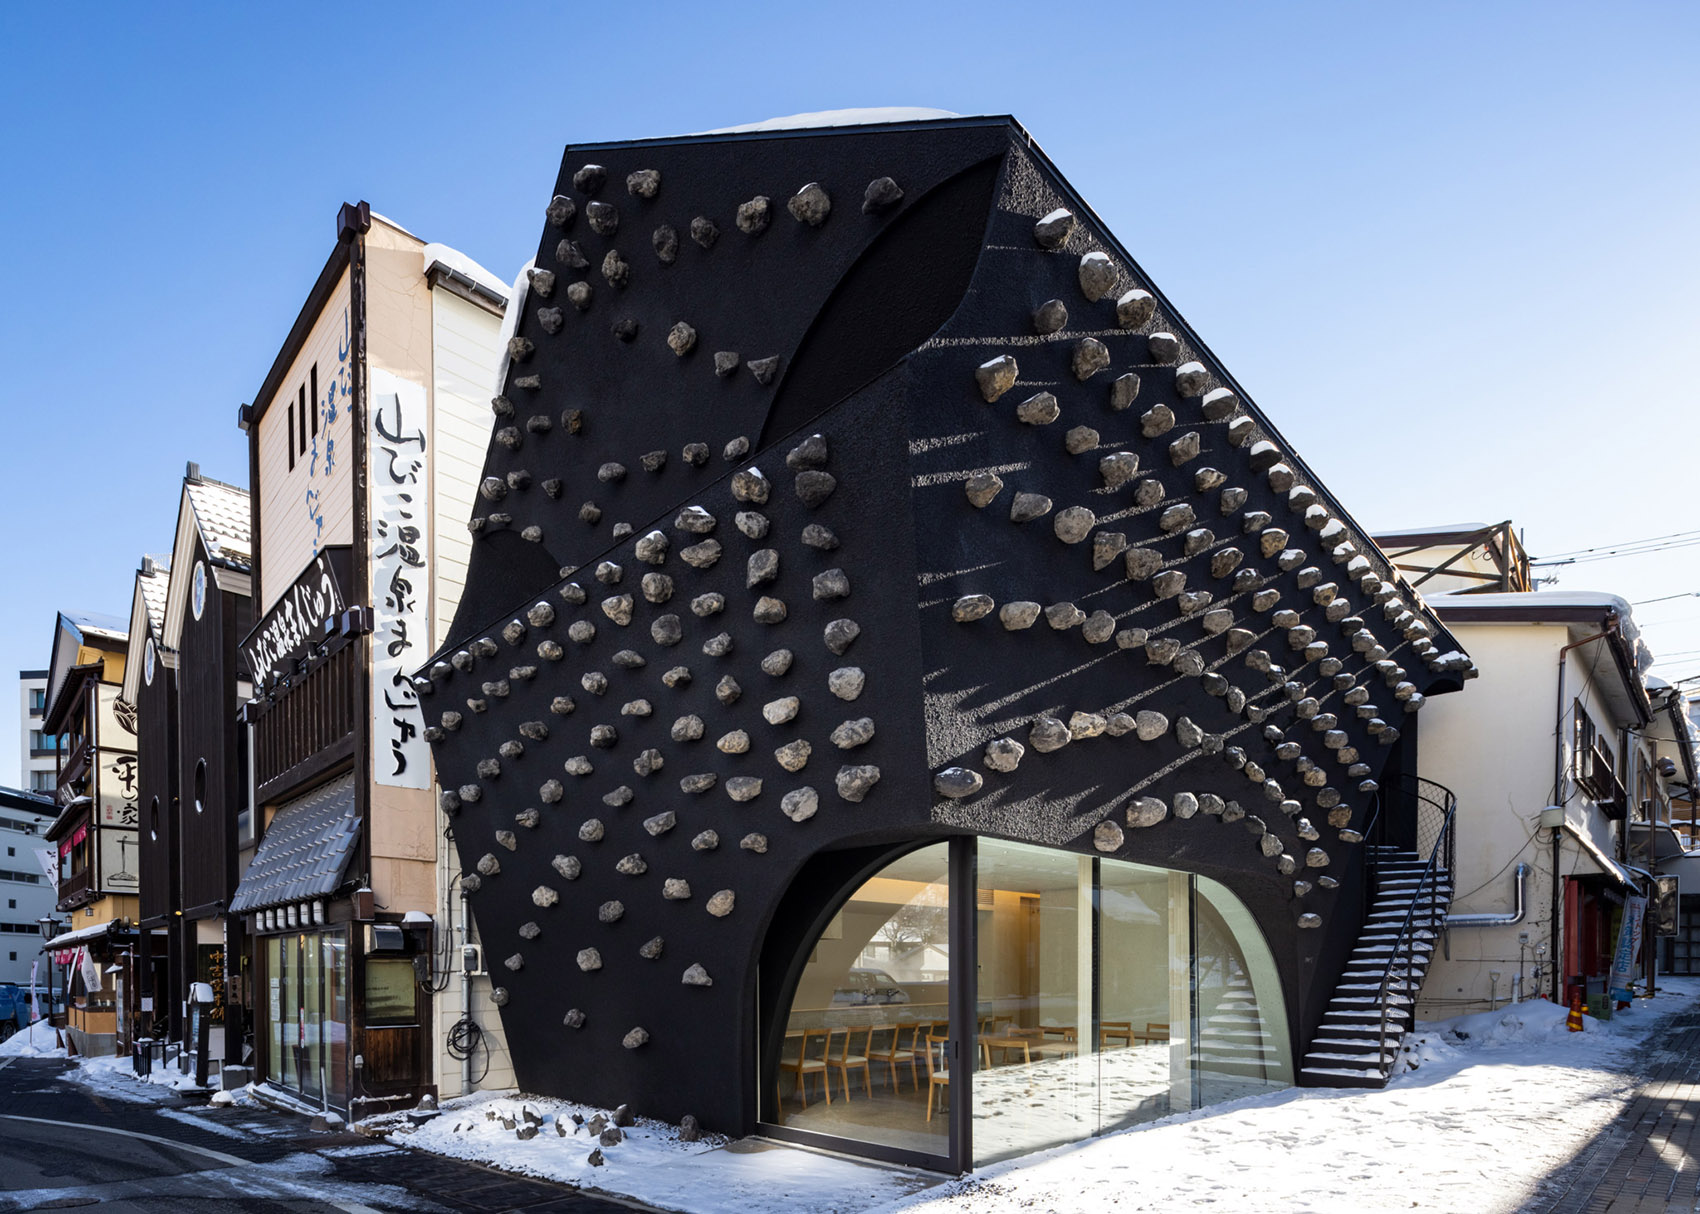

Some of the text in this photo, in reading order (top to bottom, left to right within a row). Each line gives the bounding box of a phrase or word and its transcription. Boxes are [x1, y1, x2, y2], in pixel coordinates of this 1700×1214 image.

[249, 557, 336, 685] 山びこ温泉まんじゅう
